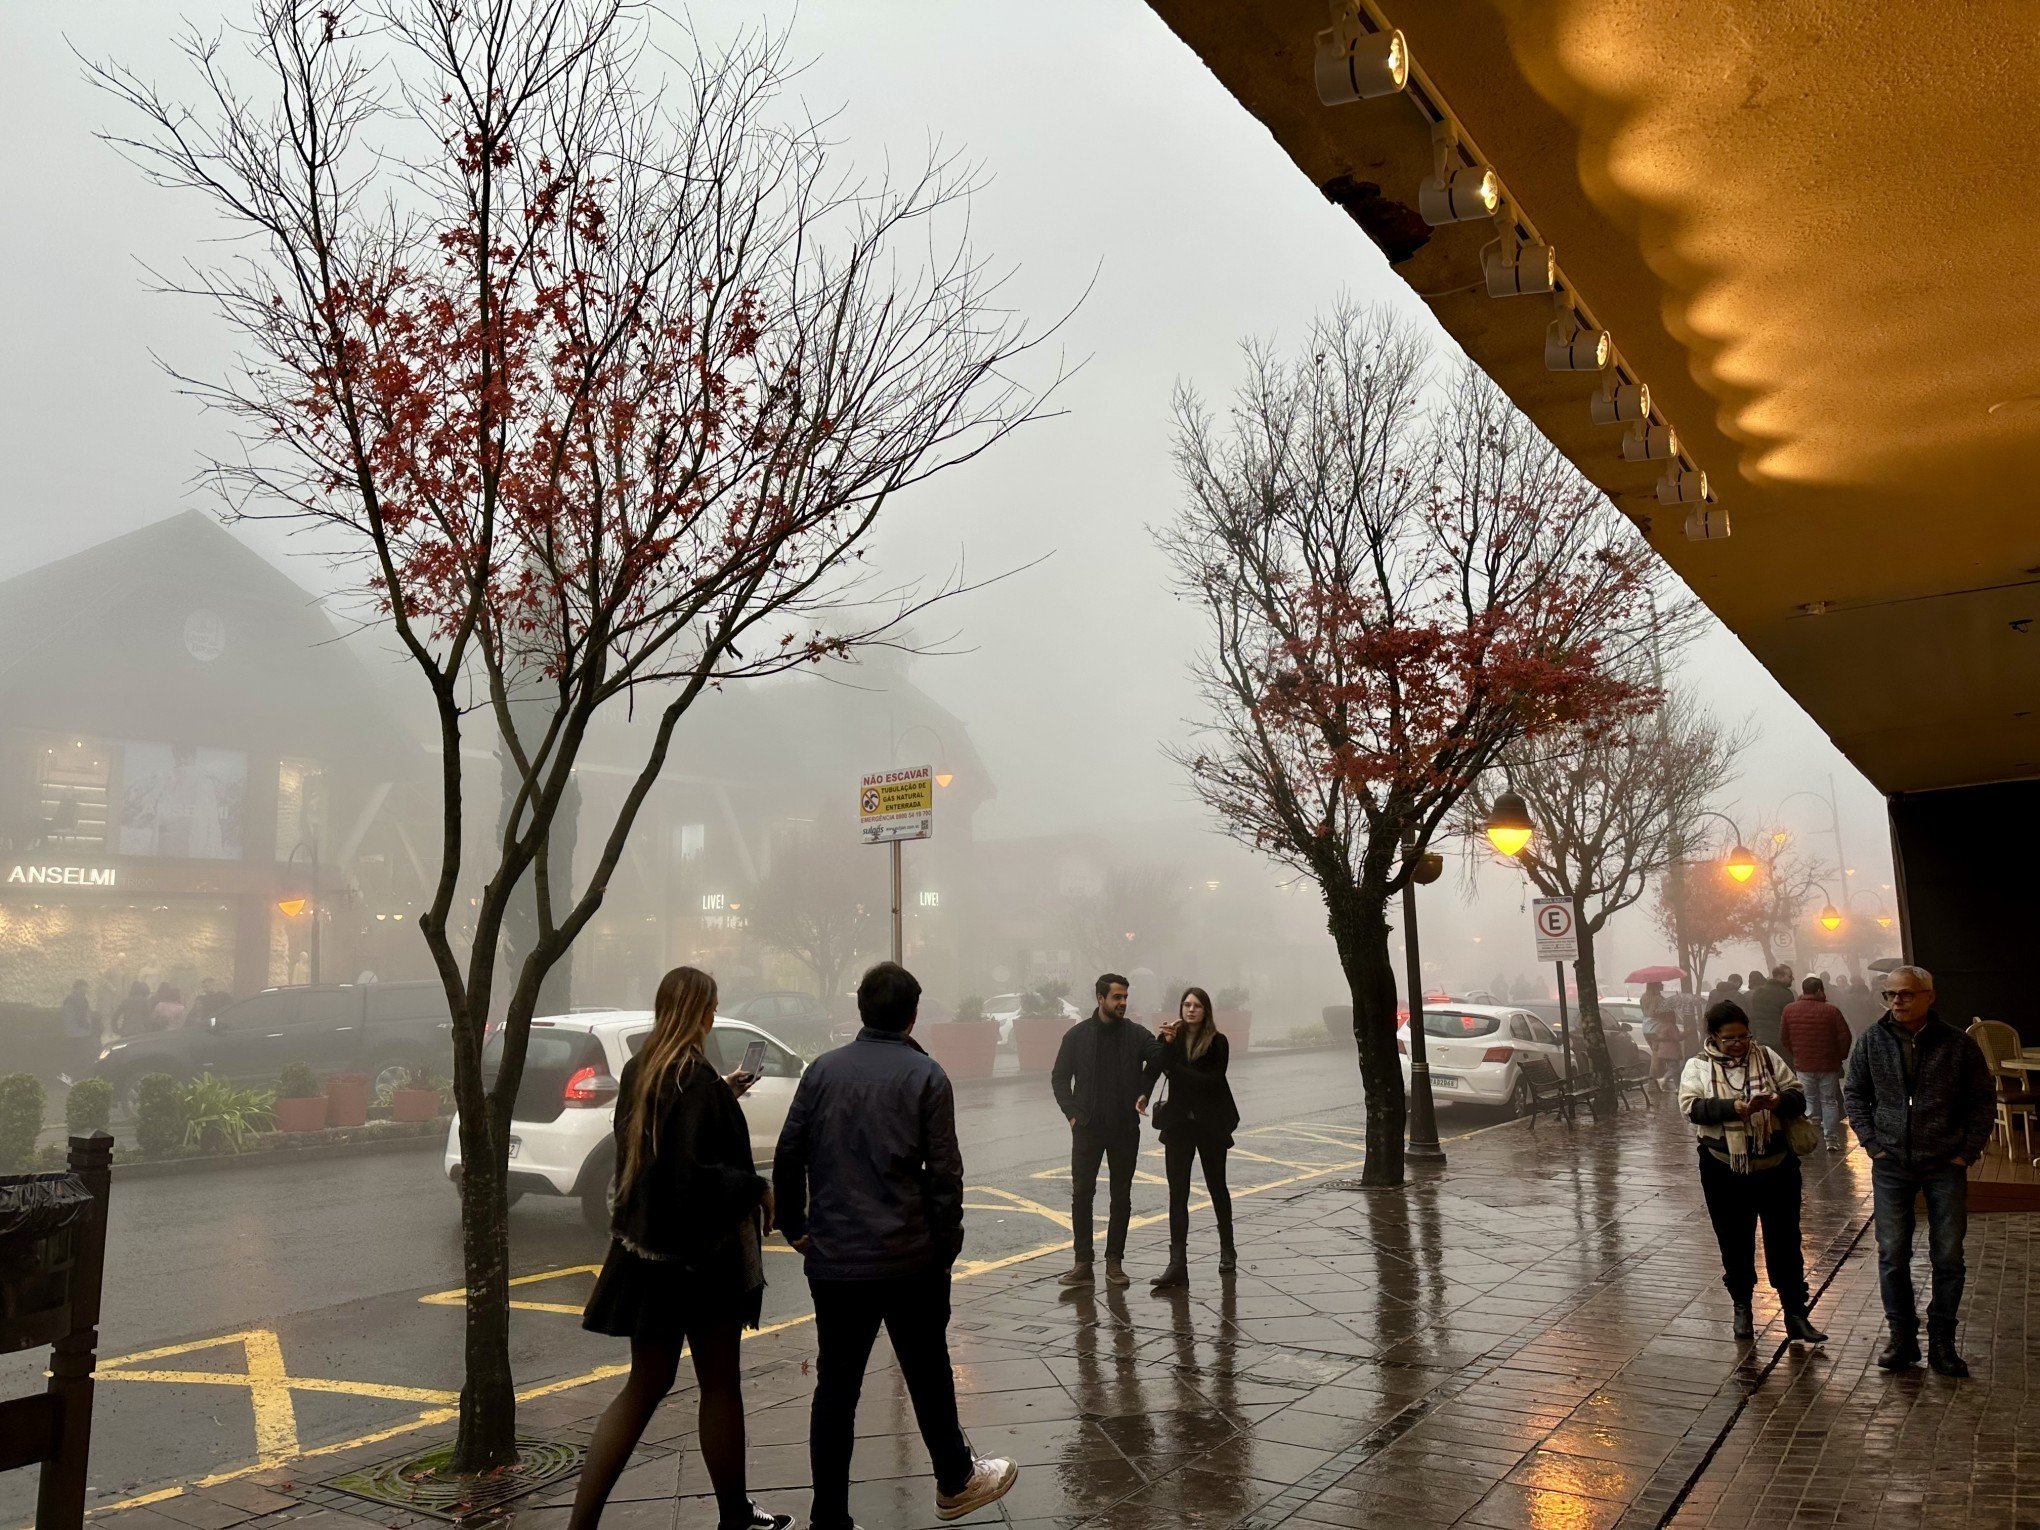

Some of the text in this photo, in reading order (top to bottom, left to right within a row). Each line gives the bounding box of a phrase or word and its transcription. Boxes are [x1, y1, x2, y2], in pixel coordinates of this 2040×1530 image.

[863, 768, 928, 786] NÃO ESCAVAR
[881, 783, 917, 794] TUBULAÇÃO
[883, 792, 924, 803] GÁS NATURAL
[885, 801, 922, 811] ENTERRADA
[8, 865, 116, 886] ANSELMI
[702, 894, 724, 910] LIVE!
[920, 891, 939, 906] LIVE!
[1548, 911, 1561, 930] E
